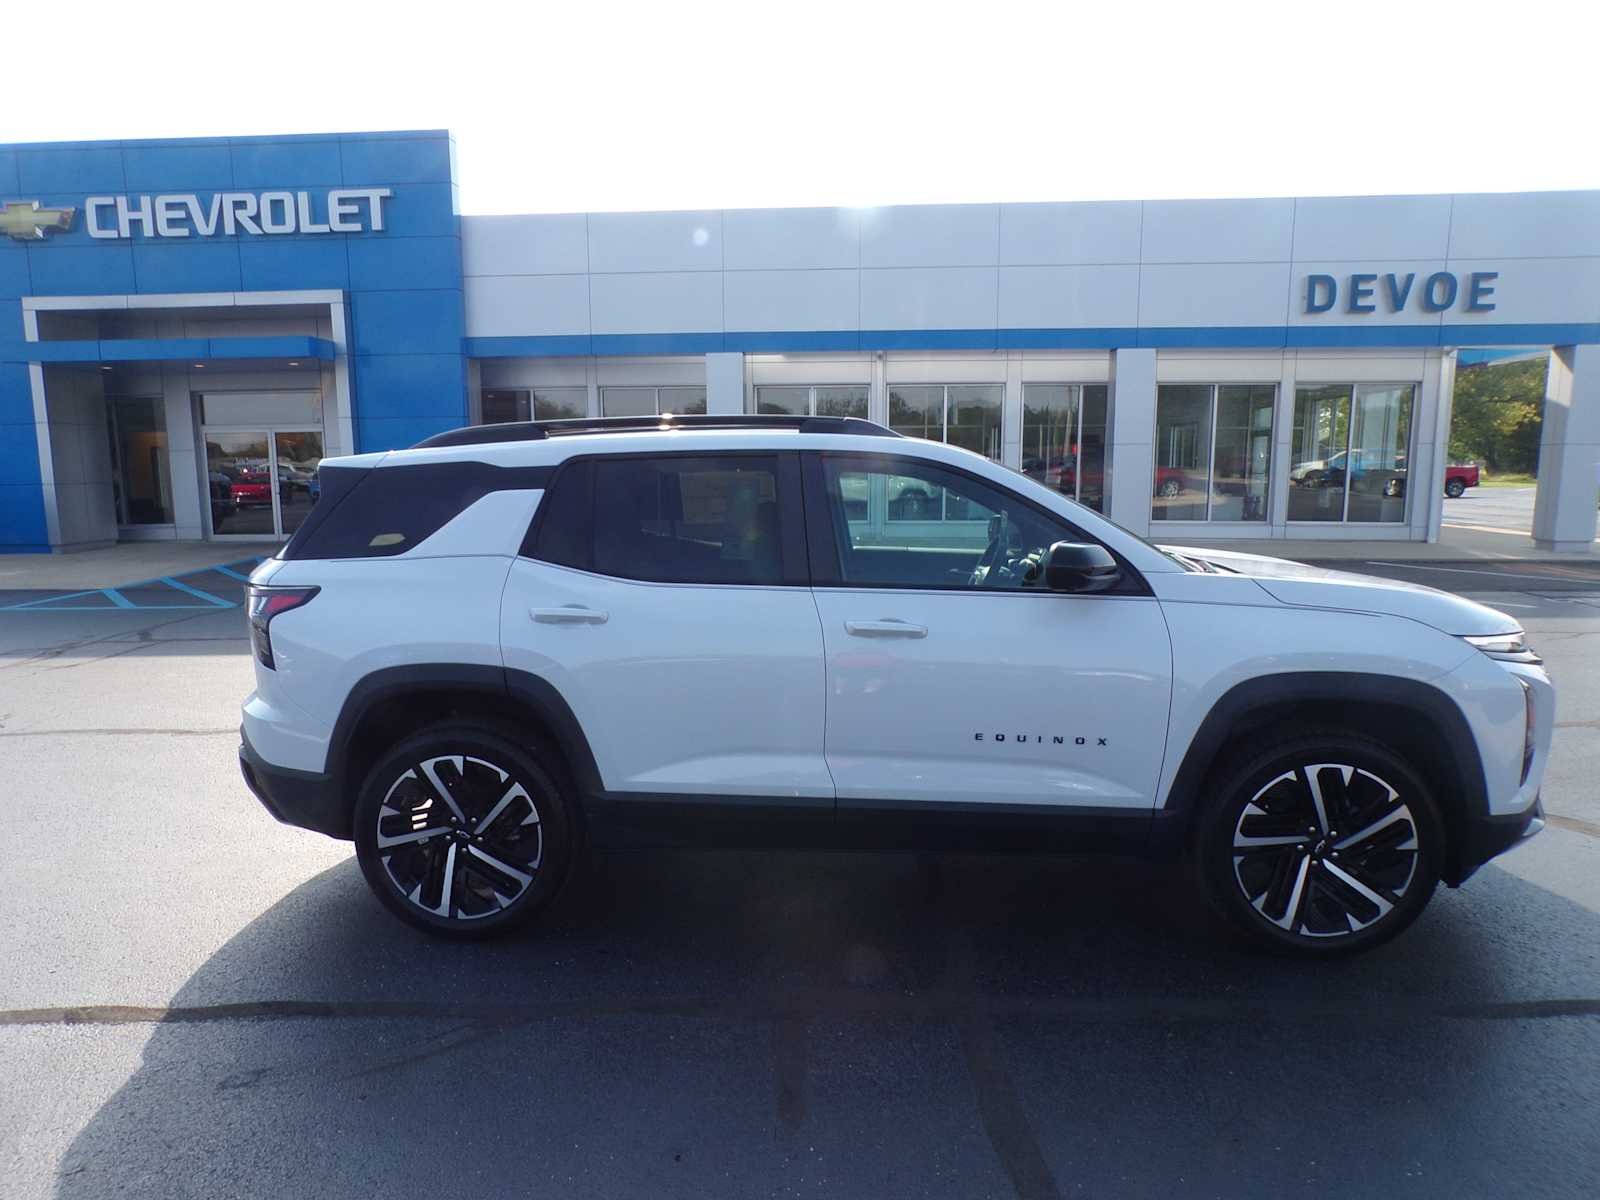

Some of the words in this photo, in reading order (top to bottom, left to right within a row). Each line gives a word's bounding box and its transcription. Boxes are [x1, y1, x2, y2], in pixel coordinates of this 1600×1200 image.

[85, 188, 391, 239] CHEVROLET
[1305, 272, 1499, 314] DEVOE
[974, 732, 1108, 747] EQUINOX
